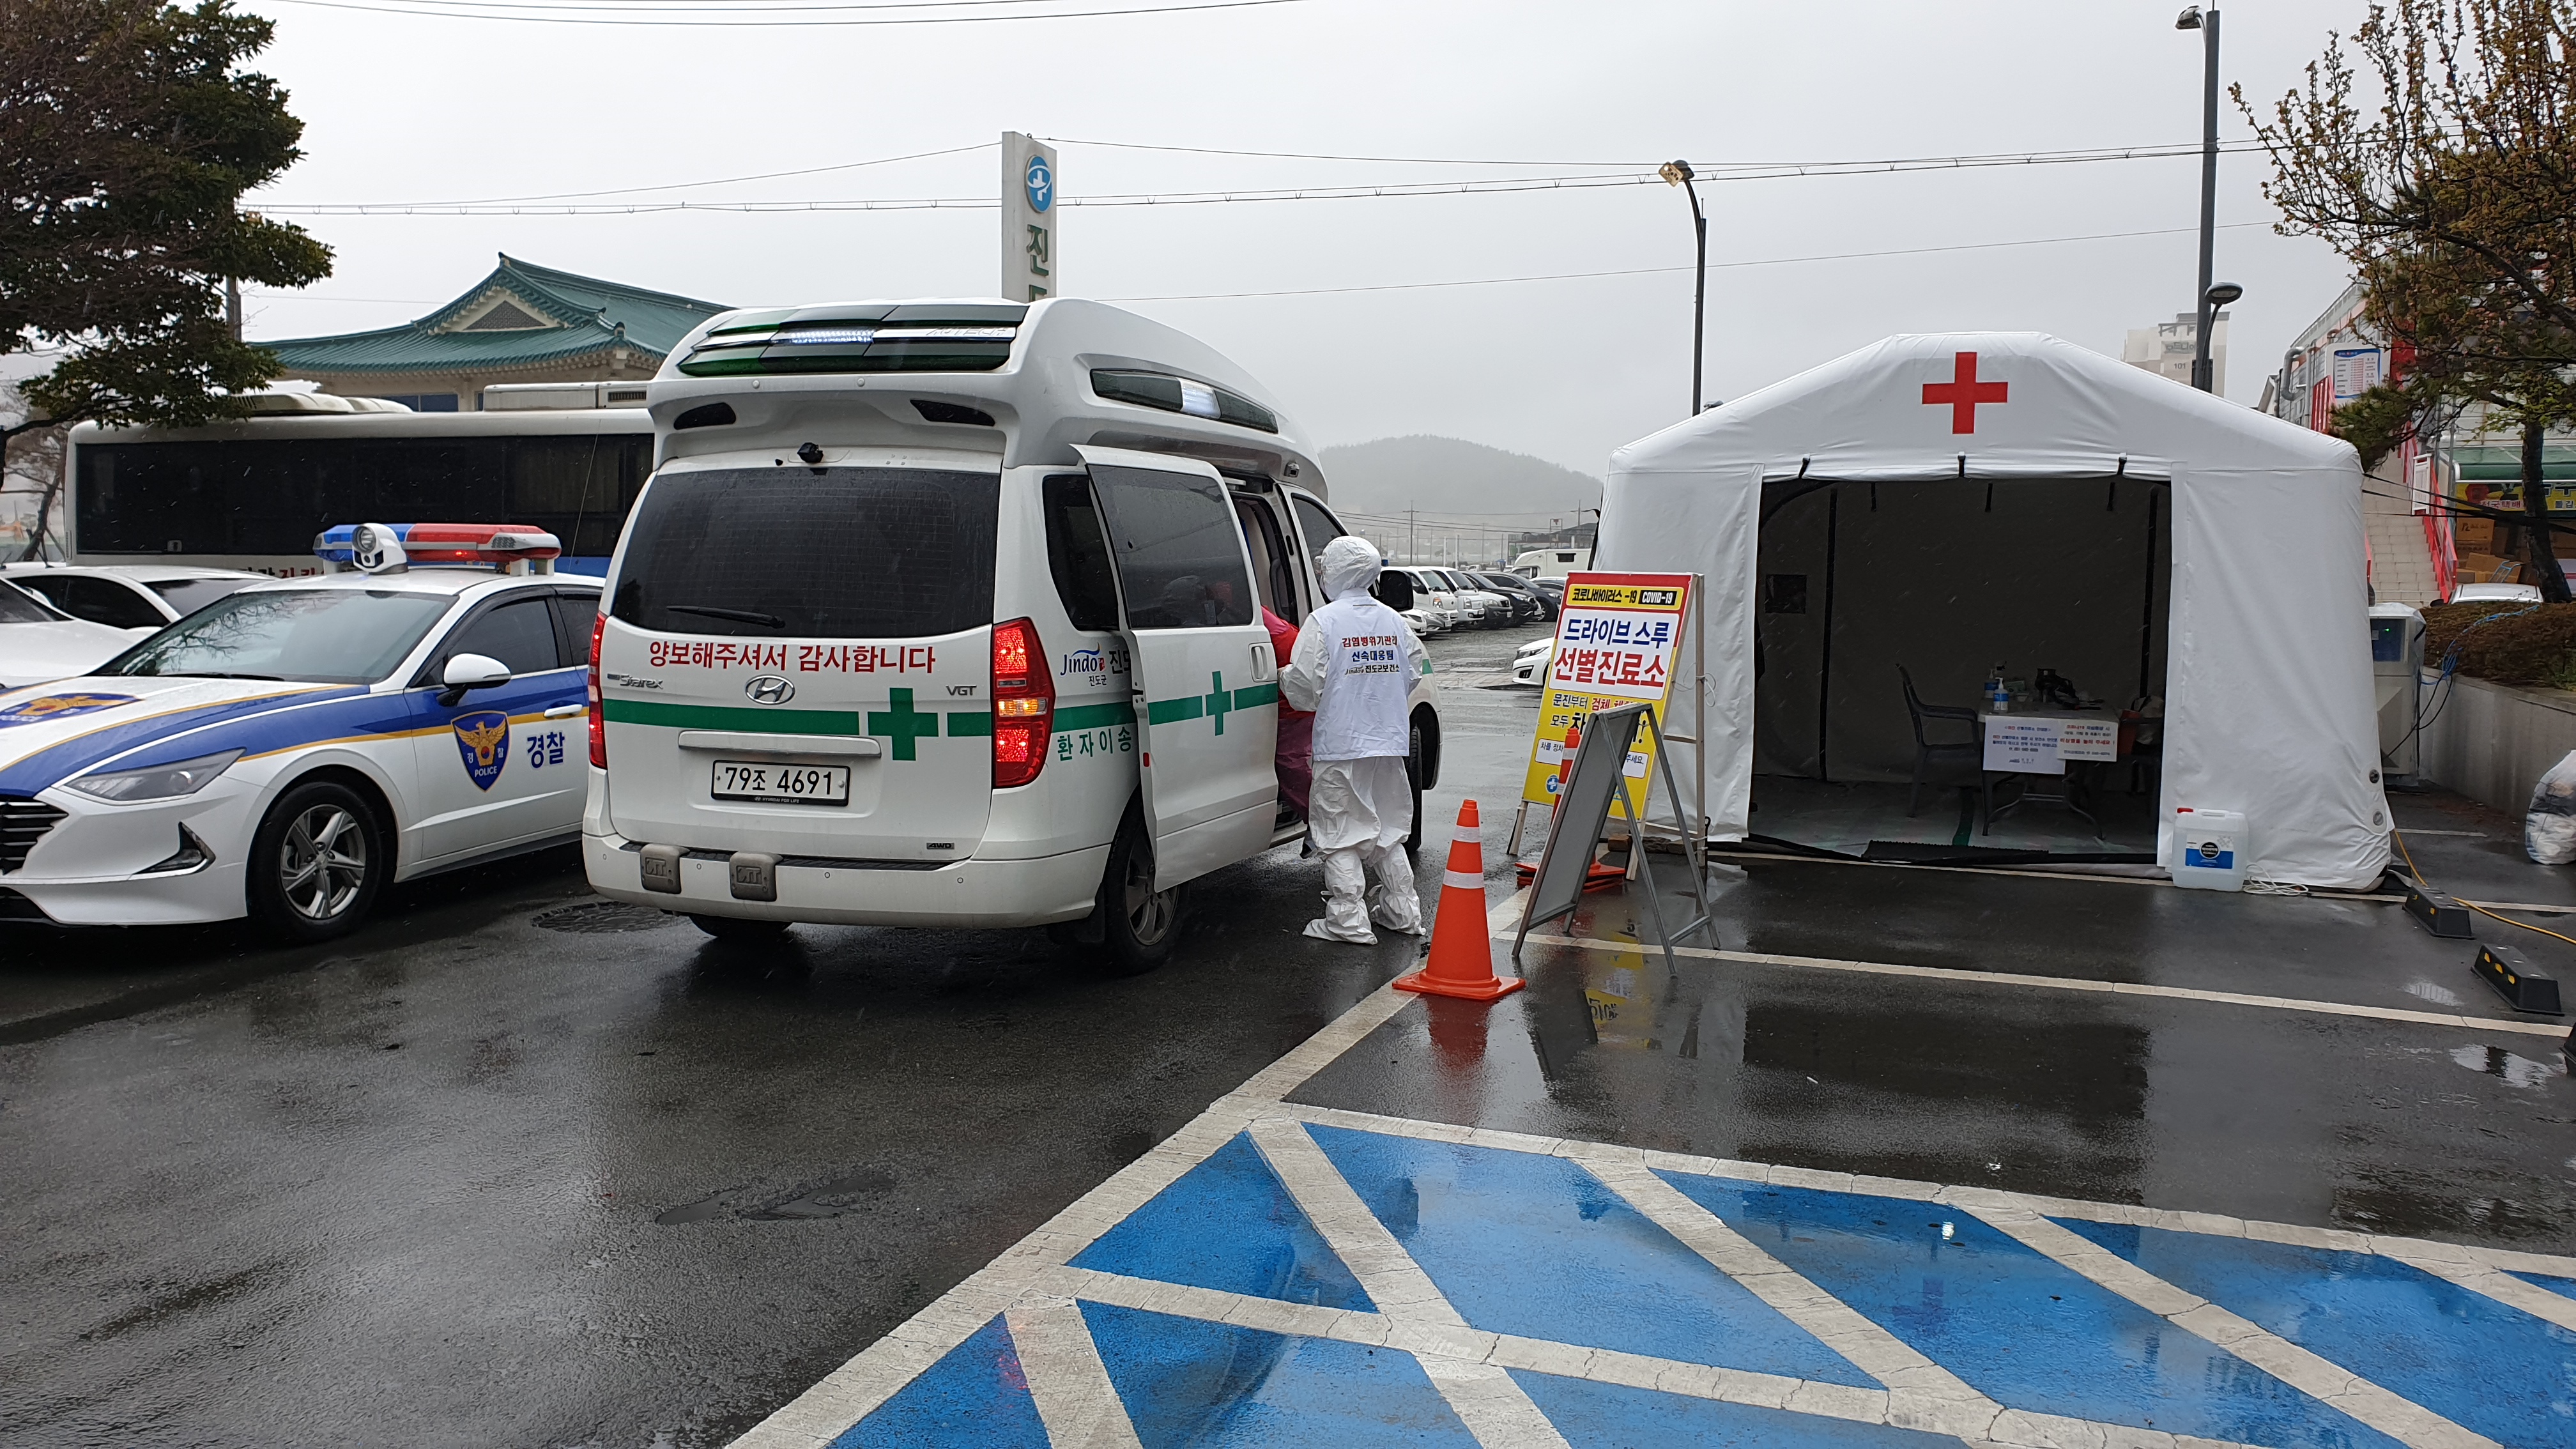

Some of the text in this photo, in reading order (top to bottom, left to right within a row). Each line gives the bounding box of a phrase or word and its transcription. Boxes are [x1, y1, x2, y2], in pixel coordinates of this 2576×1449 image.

[1572, 588, 1623, 603] 코로나바이러스
[1642, 591, 1673, 604] COVID-19
[649, 640, 936, 673] 양보해주셔서 감사합니다
[1351, 650, 1394, 663] 신속대응팀
[1060, 654, 1098, 676] Jindo
[1554, 647, 1666, 688] 선별진료소
[619, 673, 664, 689] Starex
[1088, 674, 1107, 687] 진도군
[945, 684, 977, 696] VGT
[1553, 693, 1588, 710] 문진부터
[1591, 698, 1611, 711] 검체
[1550, 715, 1568, 728] 모두
[527, 732, 565, 769] 경찰
[1540, 741, 1551, 751] 차를
[467, 747, 504, 764] 경 찰
[474, 765, 498, 778] POLICE
[724, 767, 832, 795] 79조 4691
